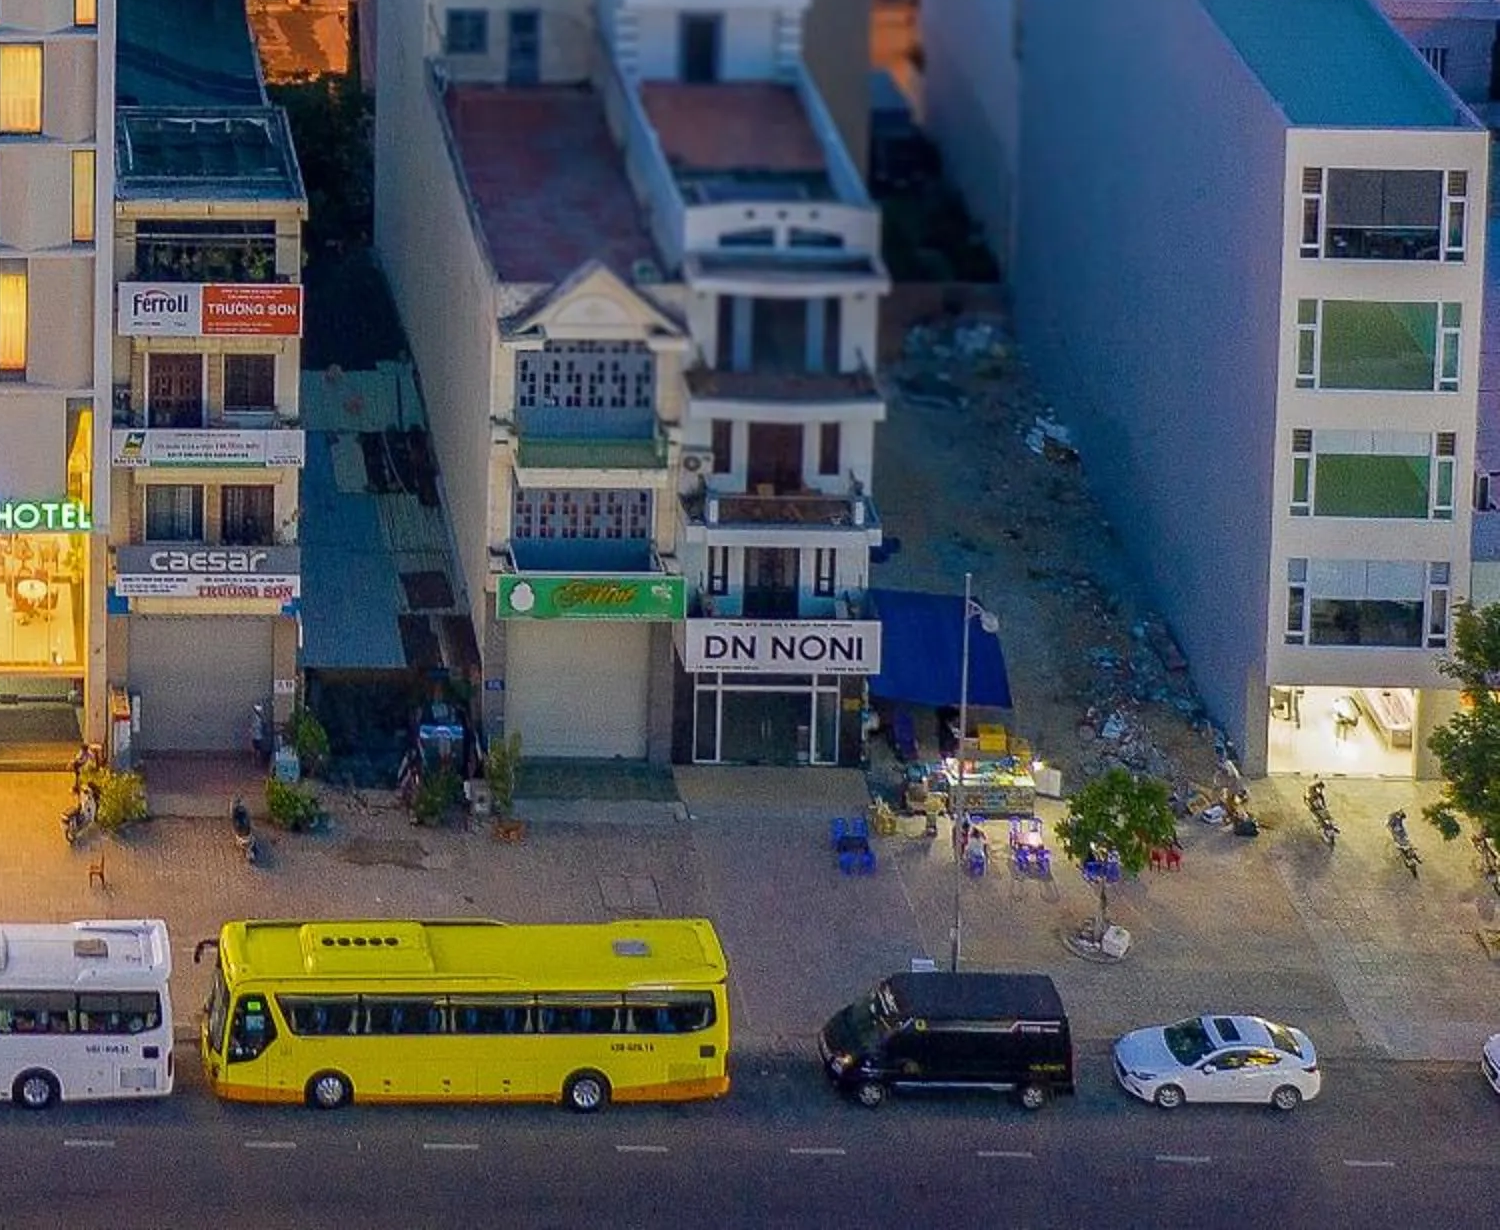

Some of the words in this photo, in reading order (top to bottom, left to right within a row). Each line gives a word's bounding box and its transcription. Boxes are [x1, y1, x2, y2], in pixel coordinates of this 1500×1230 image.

[150, 551, 267, 572] caesar
[704, 635, 757, 660] DN
[771, 635, 863, 661] NONI
